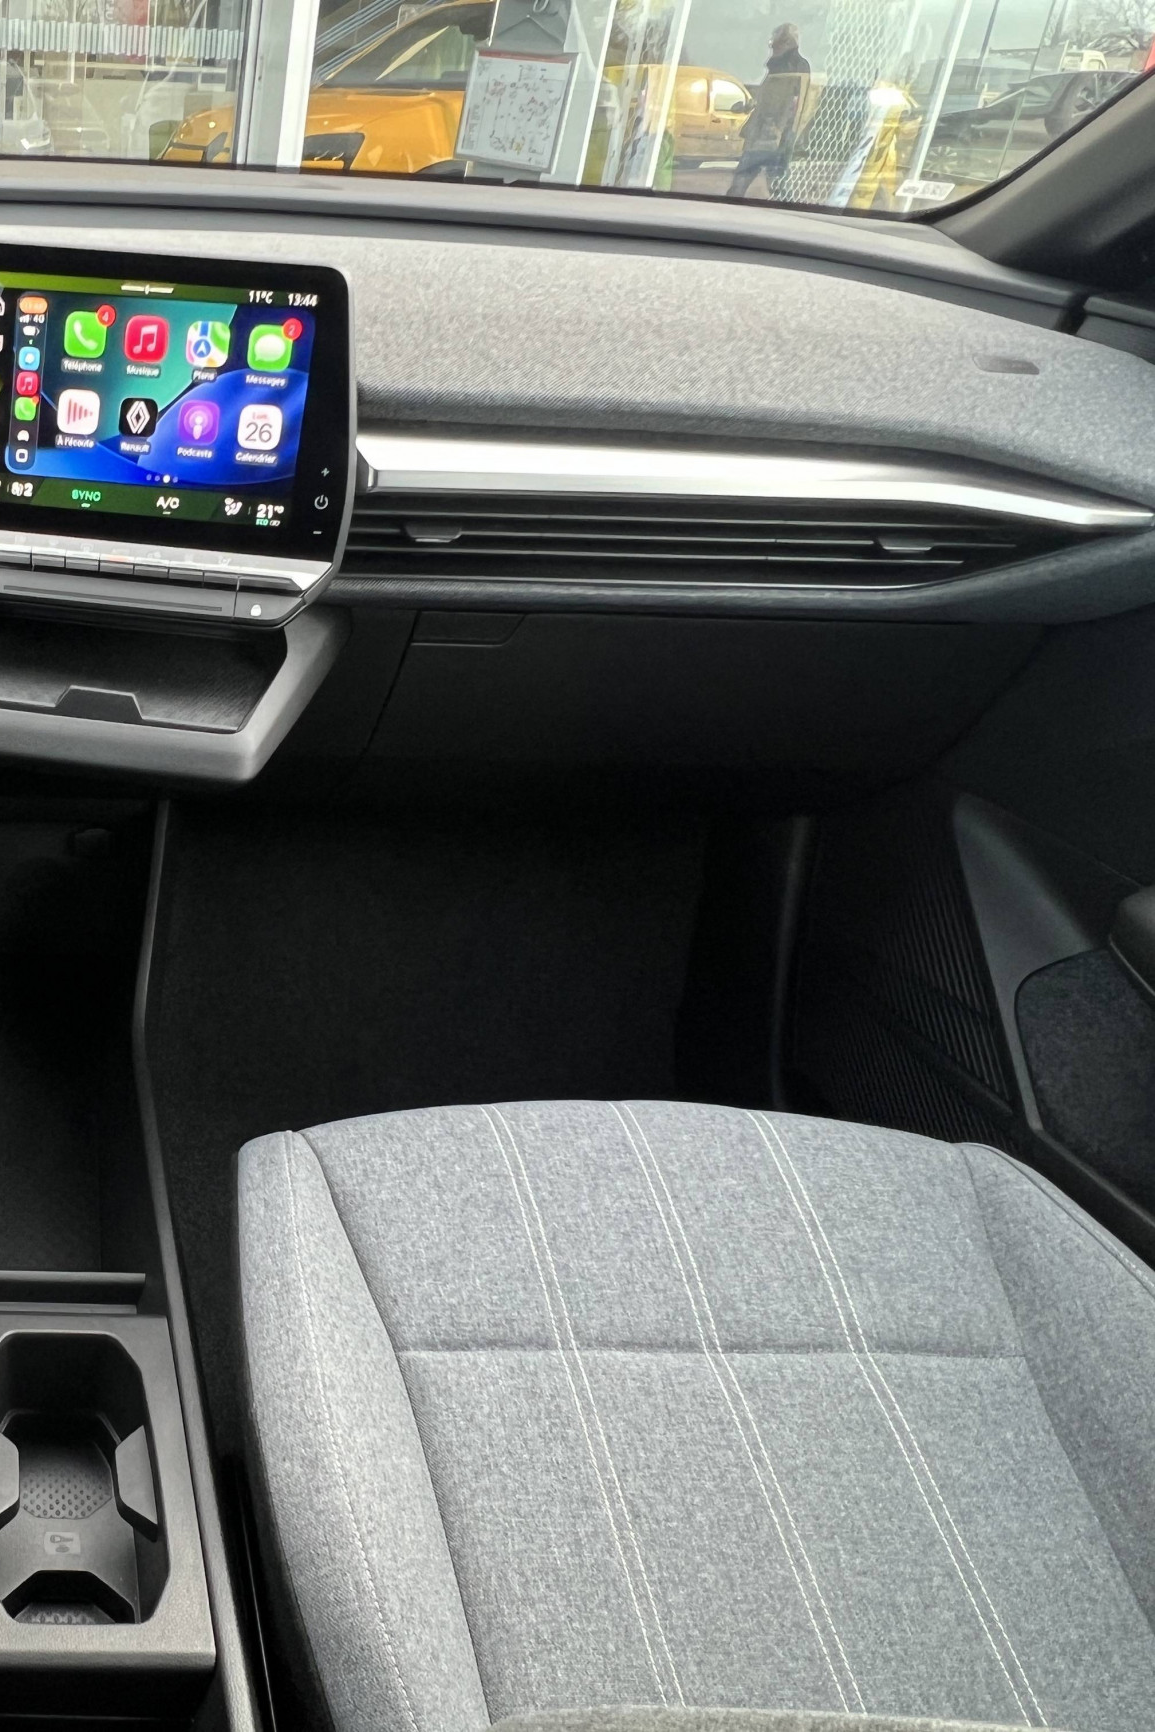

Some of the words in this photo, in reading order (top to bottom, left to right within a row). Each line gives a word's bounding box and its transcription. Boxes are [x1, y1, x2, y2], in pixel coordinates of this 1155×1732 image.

[63, 360, 103, 373] Téléphone
[126, 364, 160, 377] Musique
[245, 374, 286, 387] Messages
[245, 421, 273, 443] 26
[177, 447, 213, 458] Podcasts
[235, 451, 277, 464] Calendrier
